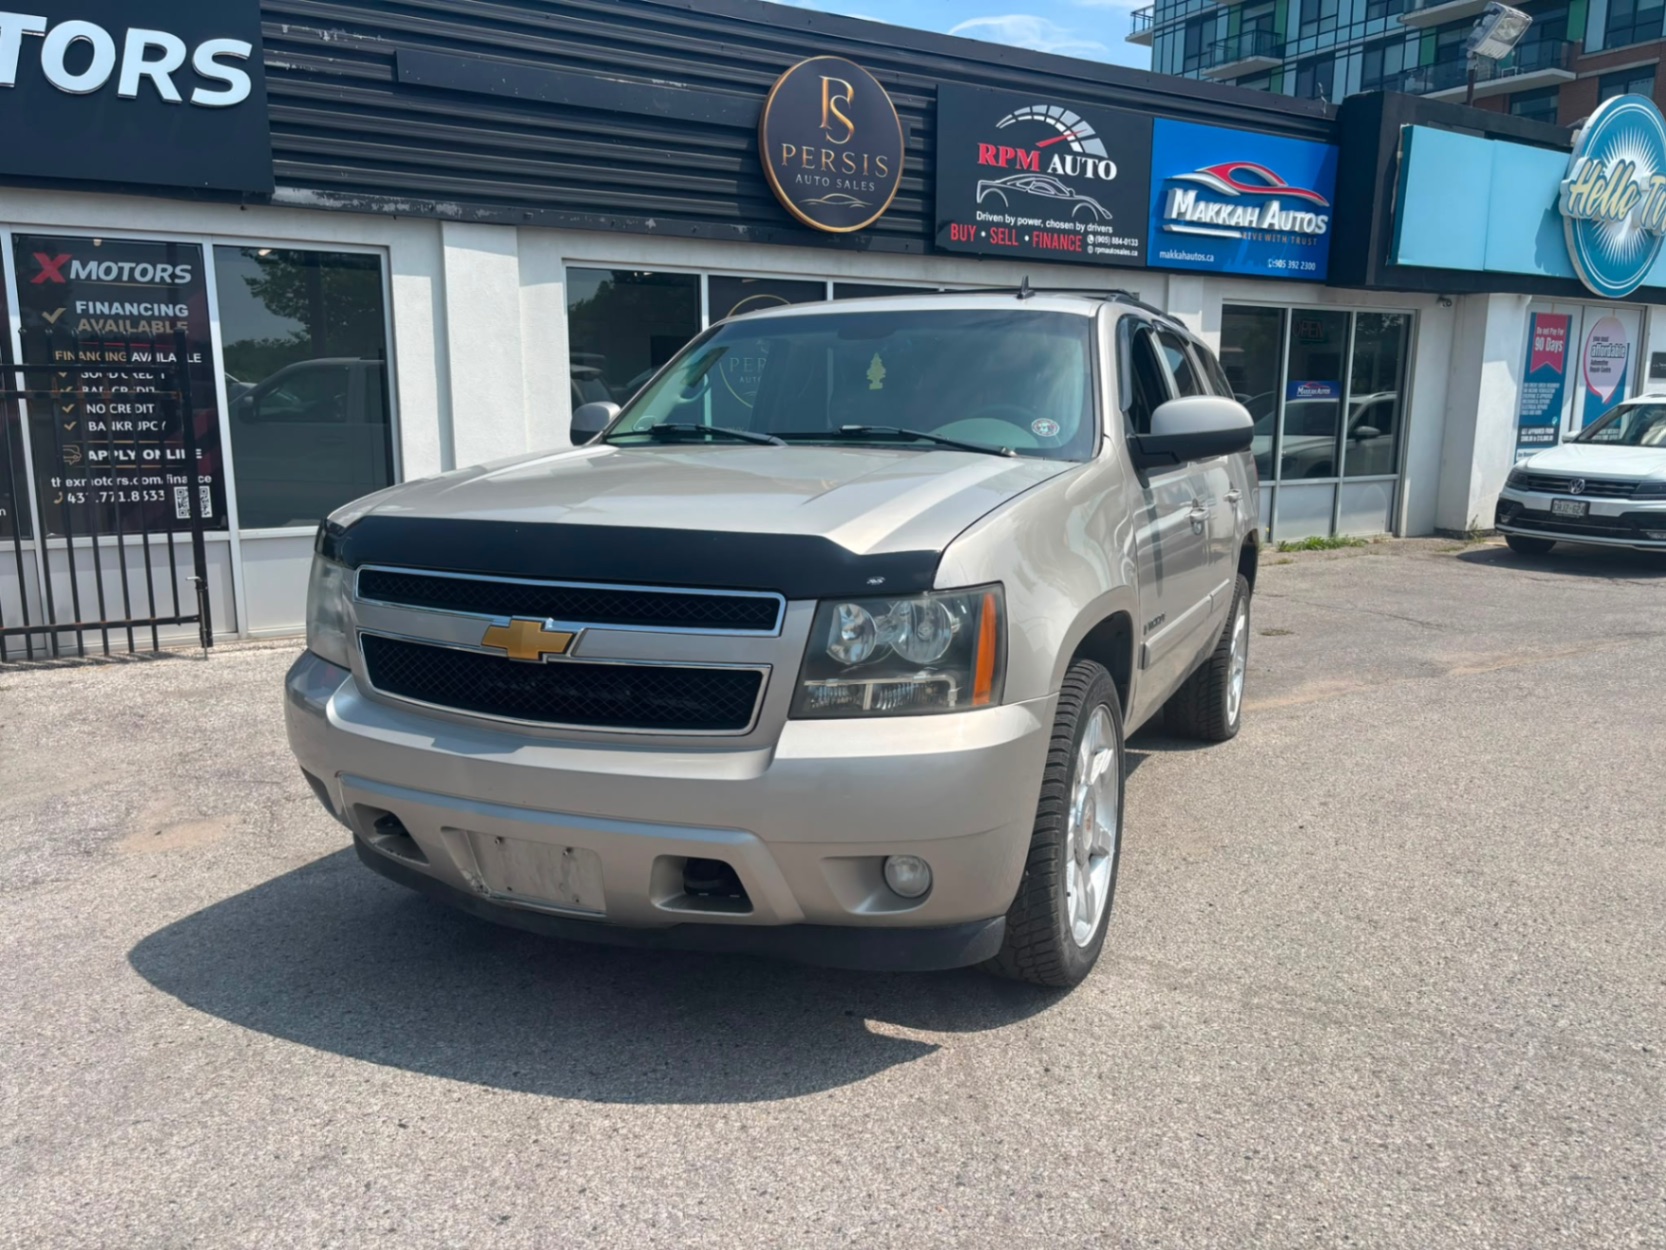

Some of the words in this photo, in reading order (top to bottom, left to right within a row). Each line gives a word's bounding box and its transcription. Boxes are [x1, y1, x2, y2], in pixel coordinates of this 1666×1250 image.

[781, 143, 888, 178] PERSIS
[977, 142, 1041, 172] RPM
[1047, 153, 1117, 181] AUTO
[795, 174, 830, 187] AUTO
[836, 178, 875, 192] SALES
[1568, 157, 1643, 222] Hello
[1166, 187, 1260, 228] MAKKAH
[1260, 199, 1329, 235] AUTOS
[976, 210, 1003, 222] Driven
[1005, 213, 1016, 226] by
[1017, 216, 1044, 228] power,
[1046, 220, 1074, 230] chosen
[1075, 221, 1085, 233] by
[1087, 223, 1113, 234] drivers
[950, 222, 977, 242] BUY
[990, 227, 1019, 246] SELL
[1032, 230, 1083, 252] FINANCE
[1265, 232, 1288, 244] WITH
[1290, 236, 1317, 246] TRUST
[1159, 249, 1215, 262] makkahautos.ca
[75, 300, 189, 317] FINANCING
[78, 318, 189, 334] AVAILABLE
[1535, 336, 1545, 352] 90
[1545, 336, 1563, 354] Days
[131, 352, 202, 363] AVAILALE
[86, 403, 106, 414] NO
[109, 403, 155, 414] CREDIT
